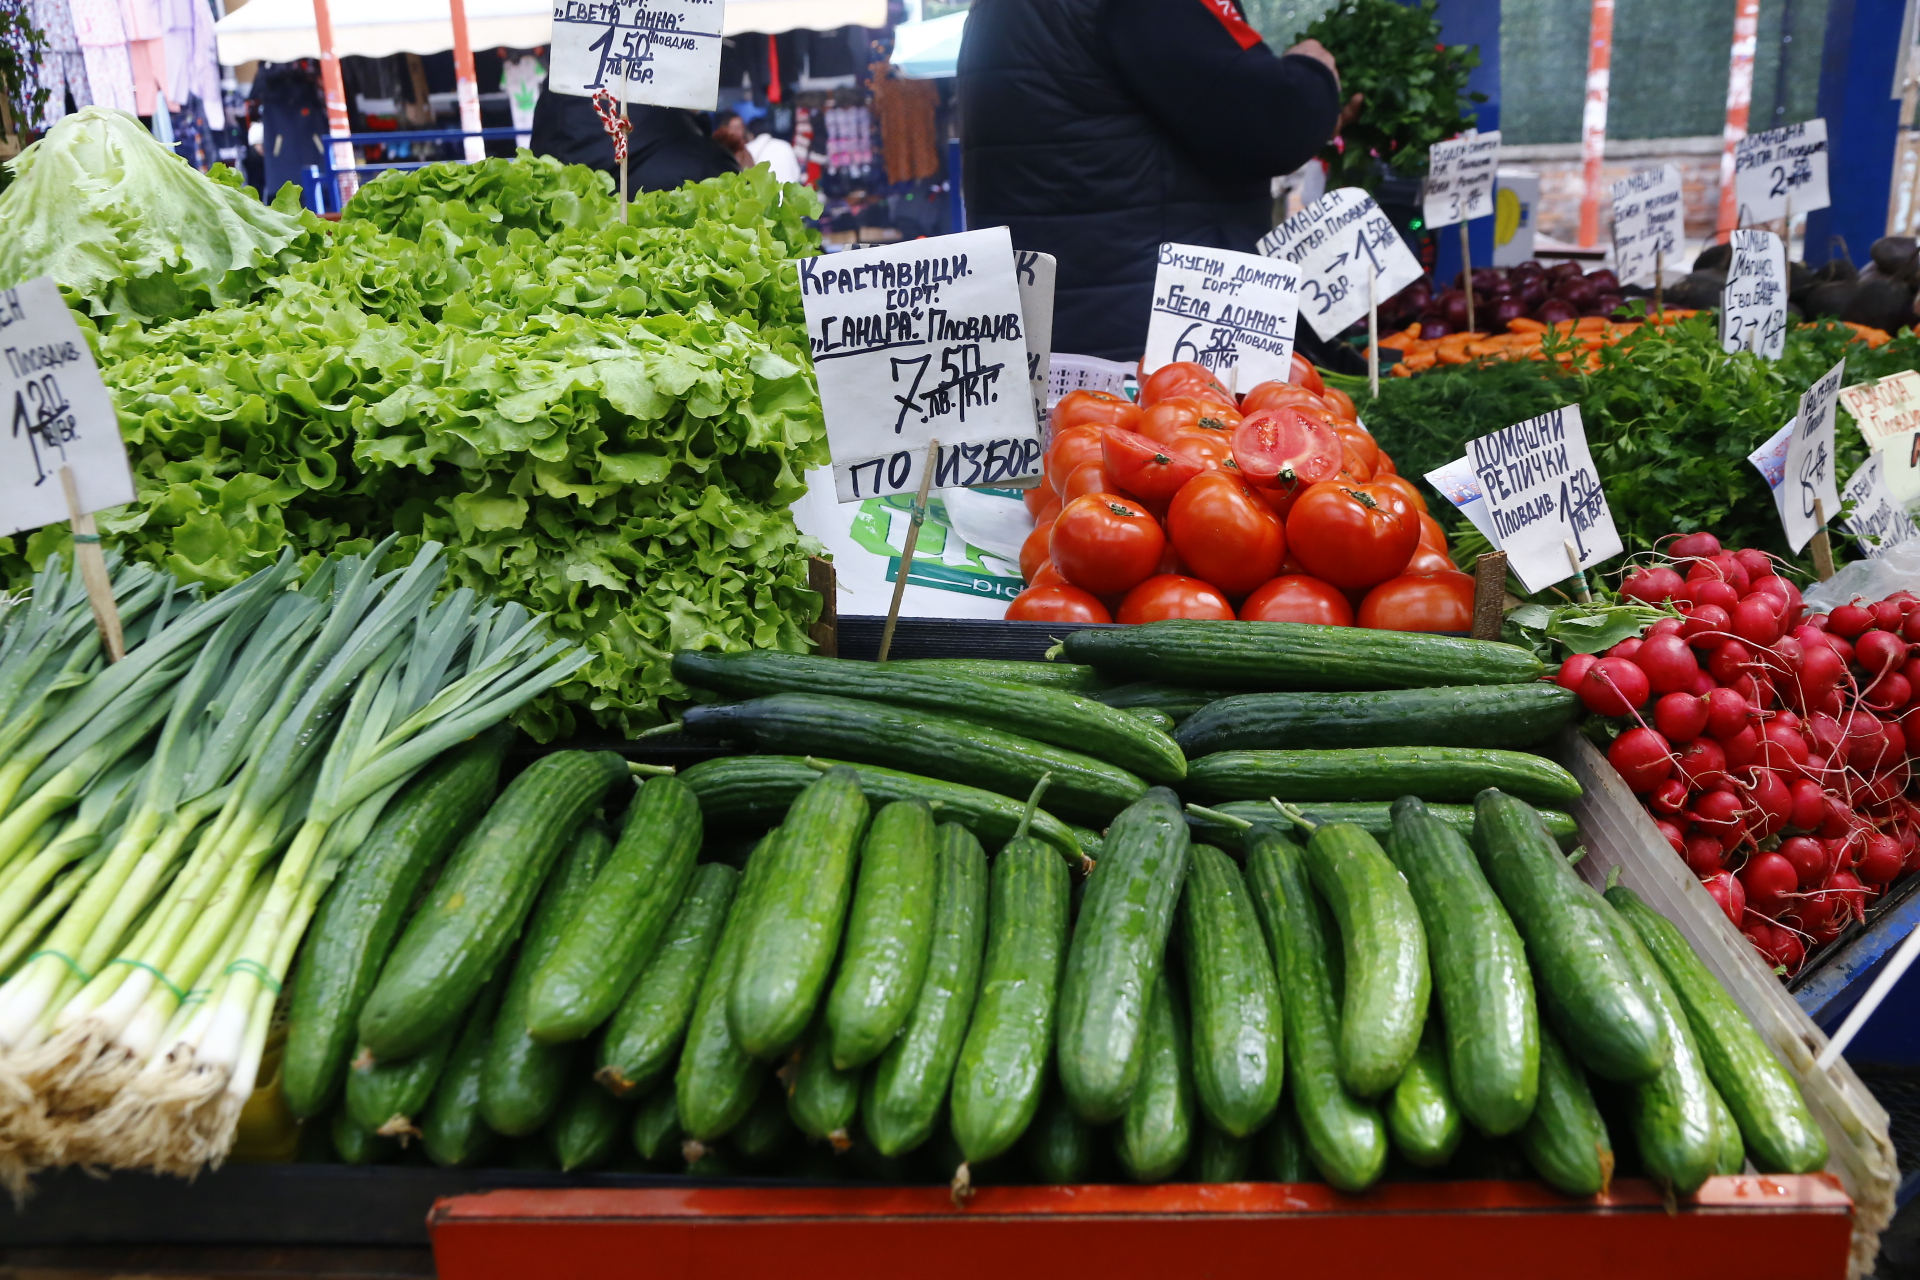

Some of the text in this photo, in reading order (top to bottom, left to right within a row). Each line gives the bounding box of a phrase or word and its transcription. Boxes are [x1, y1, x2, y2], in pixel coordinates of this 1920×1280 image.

[1262, 191, 1344, 257] ДОМАШЕН
[1272, 228, 1328, 264] ОПЪР.
[800, 253, 973, 296] КРАСТАВИЦИ.
[1158, 242, 1225, 278] ВКУСНИ
[928, 308, 1023, 343] ПЛОВДИВ.
[1474, 409, 1565, 479] ДОМАШНИ
[849, 439, 1042, 498] ПО ИЗБОР.
[1484, 443, 1570, 505] РЕПИЧКИ
[1492, 493, 1557, 539] ПЛОВДИВ.
